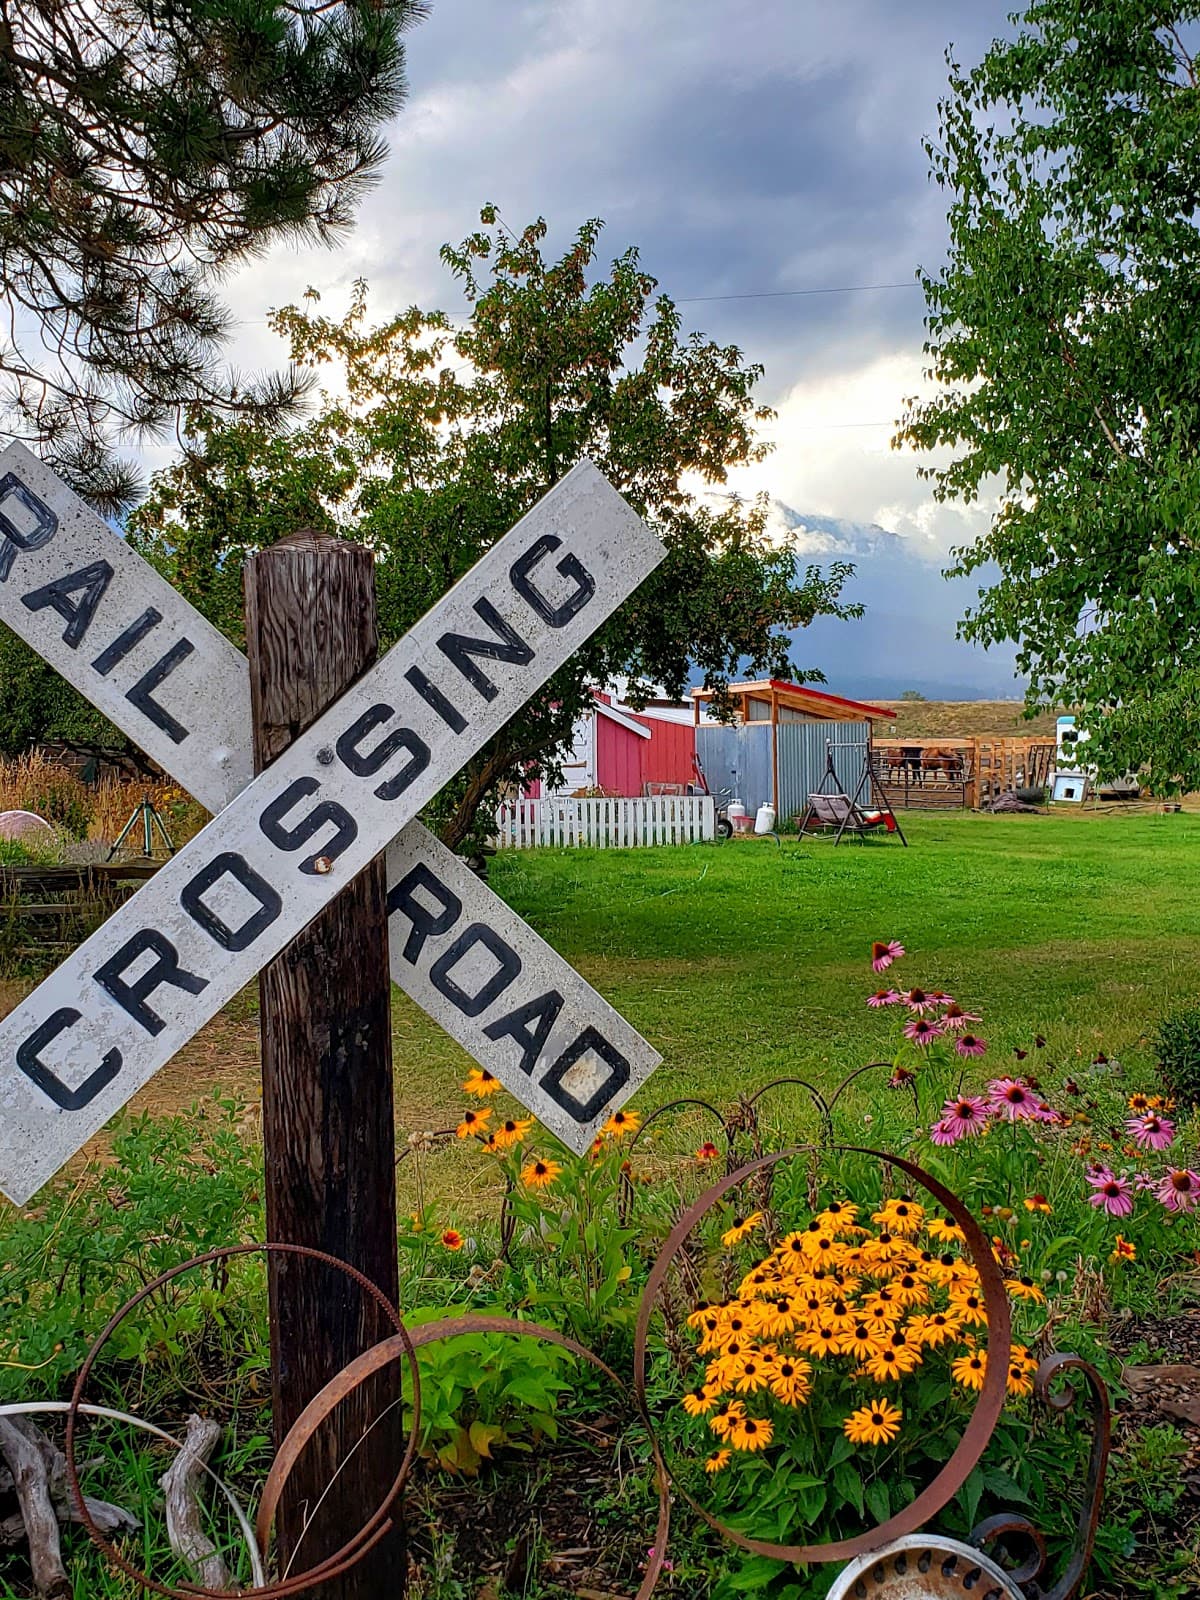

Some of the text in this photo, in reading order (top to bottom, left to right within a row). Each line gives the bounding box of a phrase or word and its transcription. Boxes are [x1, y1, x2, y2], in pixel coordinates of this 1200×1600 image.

[0, 472, 631, 1123] RAIL ROAD
[17, 534, 596, 1111] CROSSING
